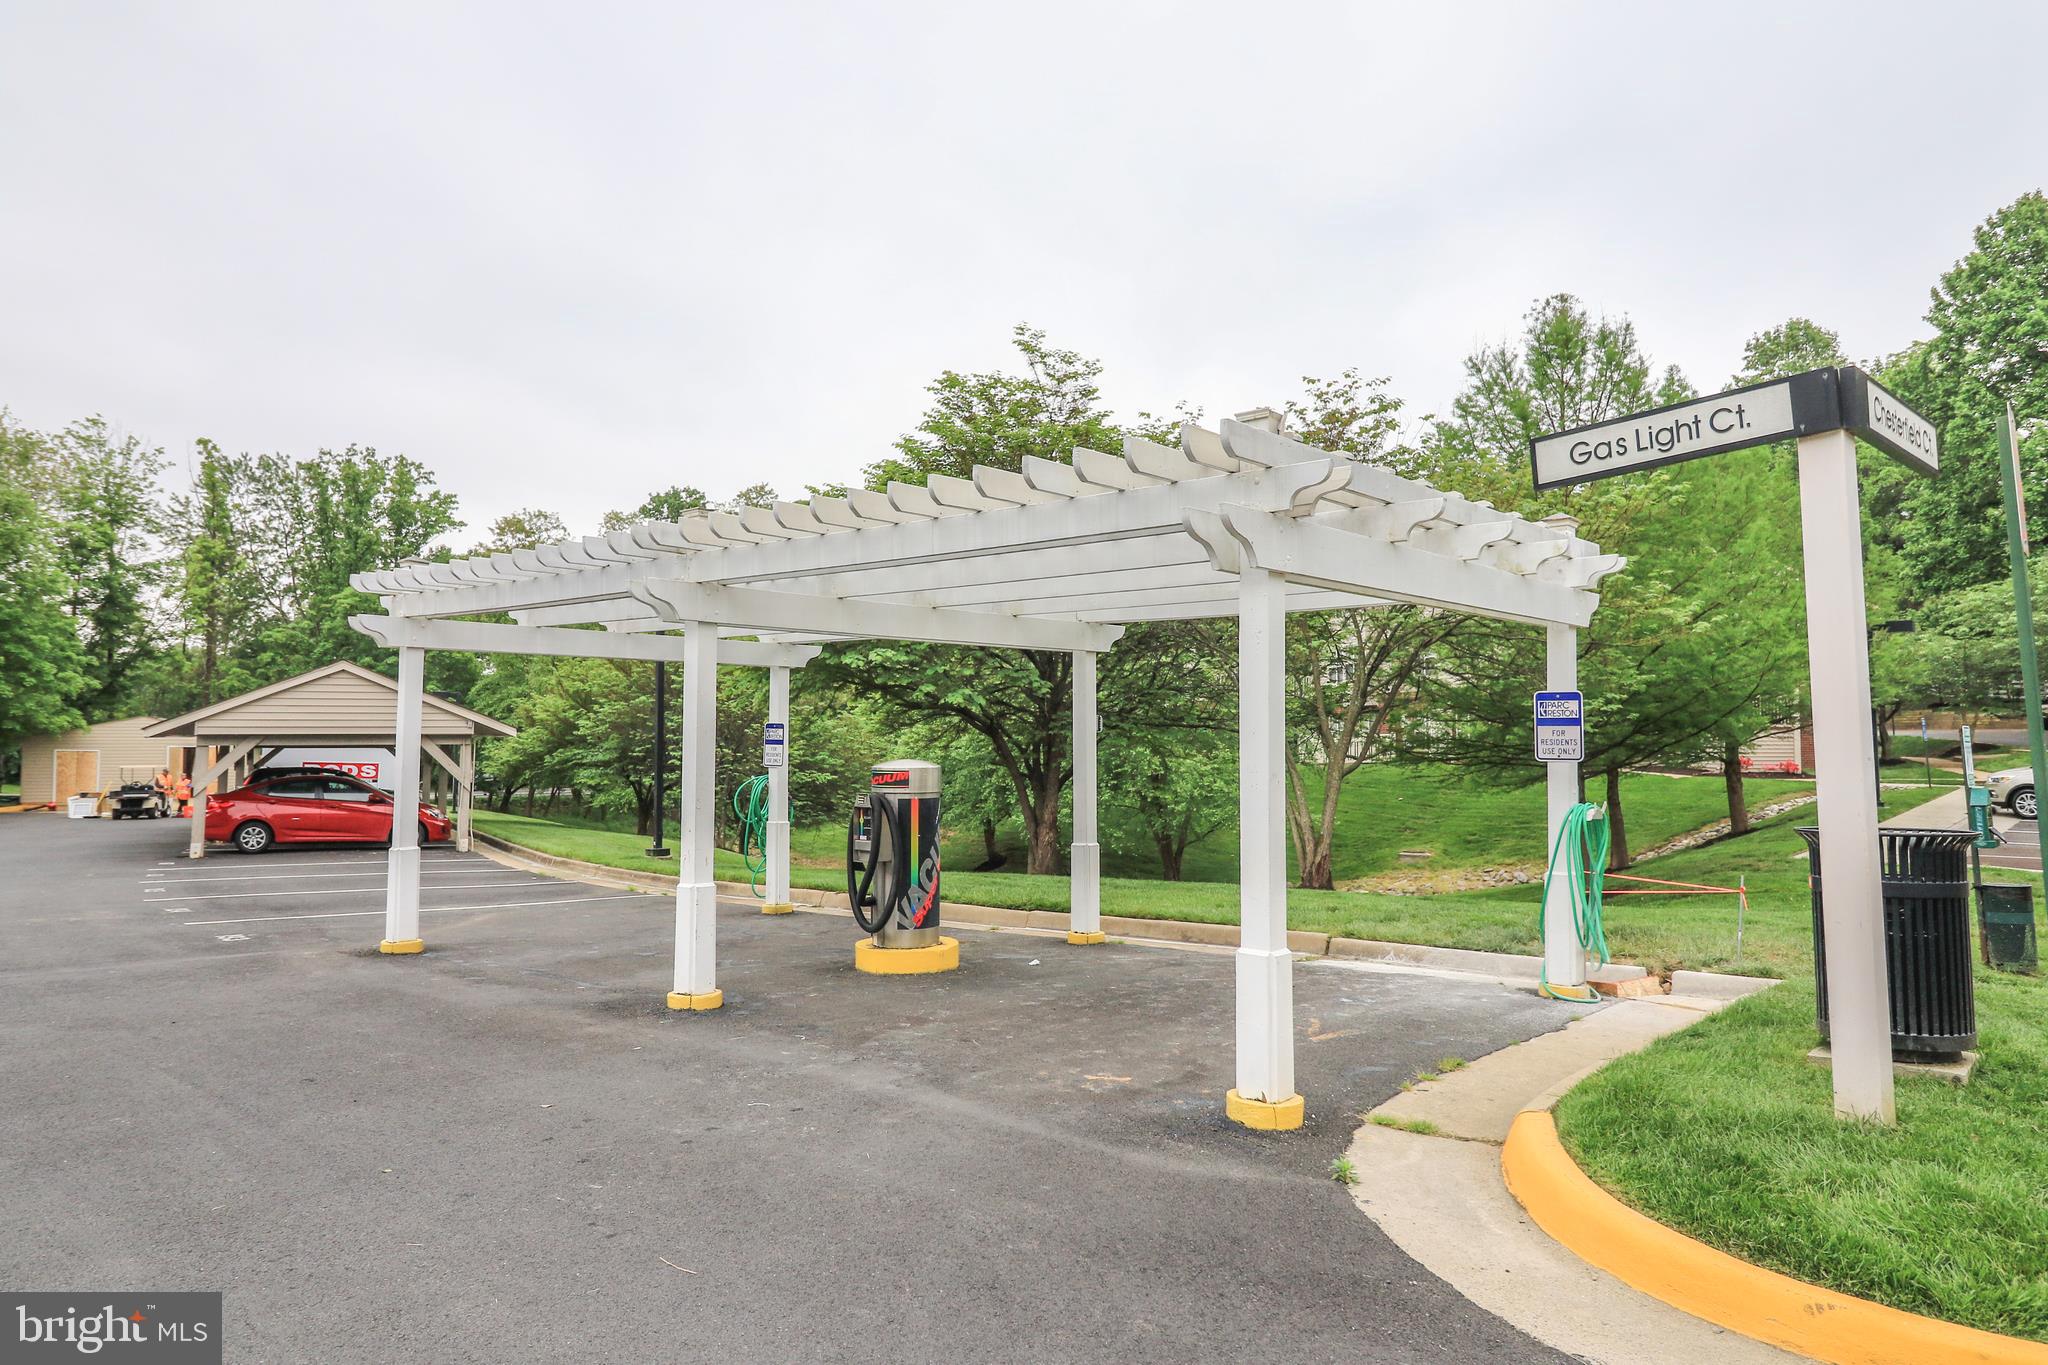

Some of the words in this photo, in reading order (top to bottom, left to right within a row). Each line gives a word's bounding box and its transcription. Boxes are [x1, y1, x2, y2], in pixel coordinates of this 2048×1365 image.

[1873, 396, 1922, 448] Chesterfield
[1569, 437, 1628, 465] Gas
[1635, 414, 1701, 453] Light
[1709, 404, 1751, 434] Ct.
[1547, 701, 1569, 709] PARC
[1547, 709, 1578, 717] RESTON
[1552, 729, 1566, 737] FOR
[1540, 738, 1578, 746] RESIDENTS
[1542, 747, 1556, 755] USE
[1557, 747, 1577, 755] ONLY
[872, 771, 910, 785] CUUM
